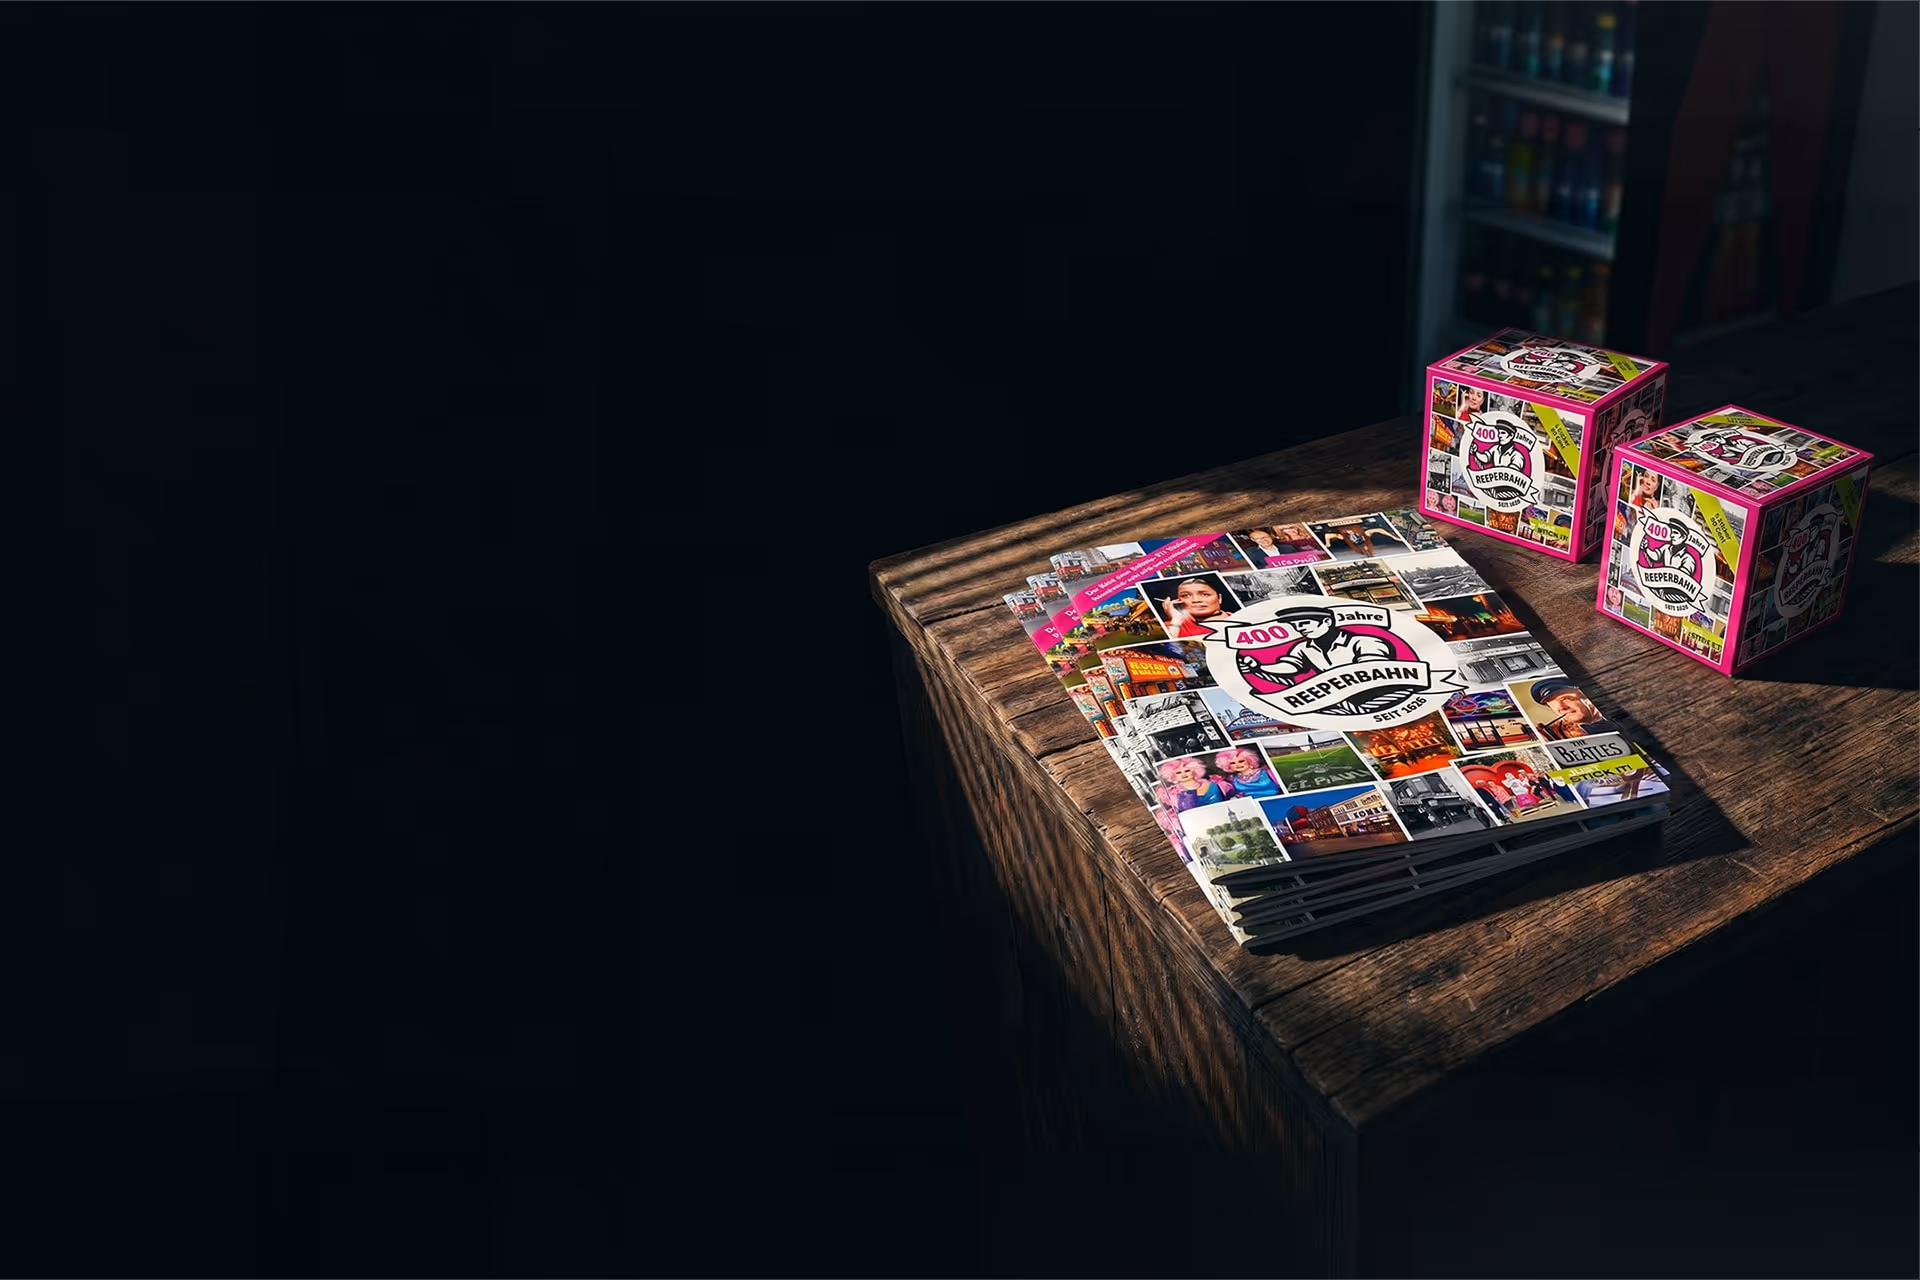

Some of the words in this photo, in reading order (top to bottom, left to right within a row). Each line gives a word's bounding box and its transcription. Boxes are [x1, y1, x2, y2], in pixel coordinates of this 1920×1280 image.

[1475, 427, 1496, 440] 400
[1515, 432, 1533, 446] Jahre
[1475, 471, 1527, 489] REEPERBAHN
[1647, 523, 1668, 539] 400
[1688, 535, 1706, 551] Jahre
[1644, 572, 1697, 594] REEPERBAHN
[1236, 625, 1290, 645] 400
[1337, 611, 1384, 624] Jahre
[1283, 667, 1420, 708] REEPERBAHN
[1373, 709, 1402, 723] SEIT
[1401, 697, 1427, 714] 1626
[1554, 742, 1623, 763] BEATLES
[1569, 739, 1588, 747] THE
[1570, 768, 1615, 783] STICK
[1614, 764, 1633, 774] IT!
